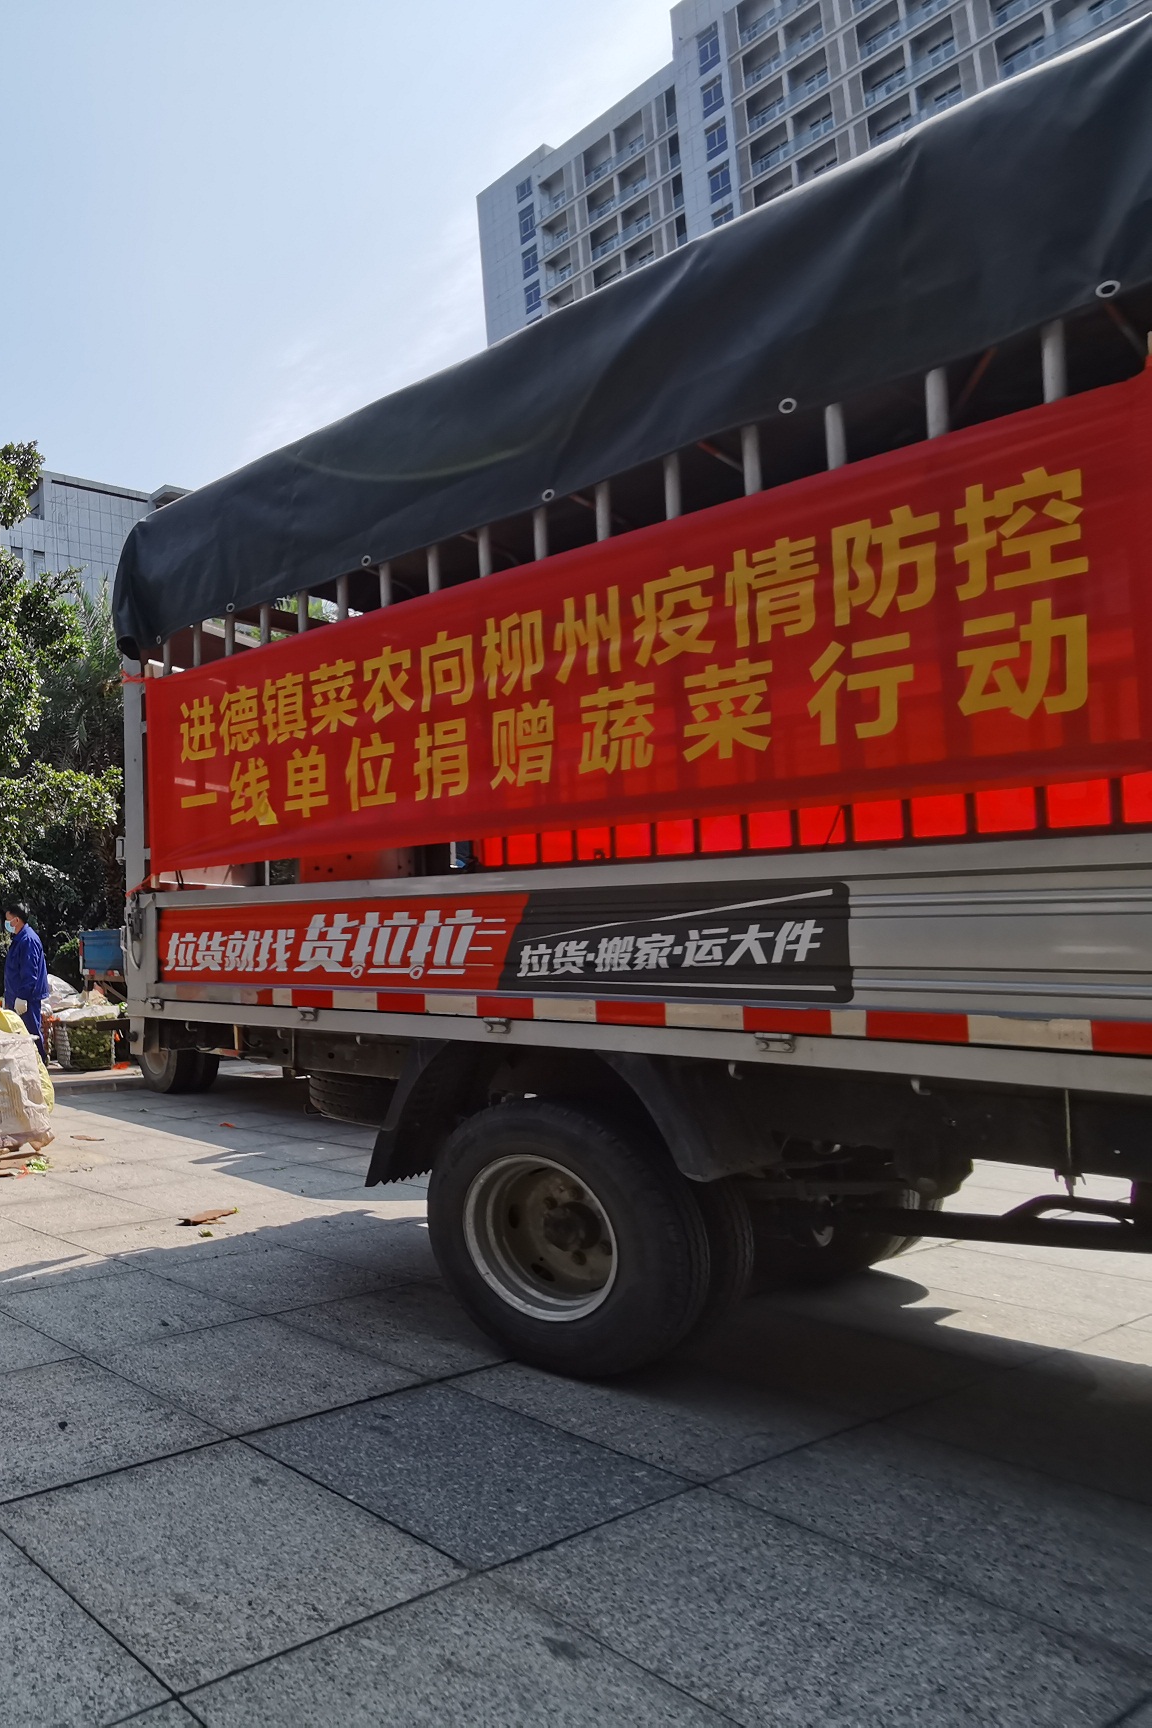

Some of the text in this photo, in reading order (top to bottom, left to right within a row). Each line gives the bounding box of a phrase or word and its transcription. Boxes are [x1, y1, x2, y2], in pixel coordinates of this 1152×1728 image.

[180, 466, 1089, 764] 进德镇菜农向柳州疫情防控
[180, 599, 1089, 827] 一线单位捐赠蔬菜行动
